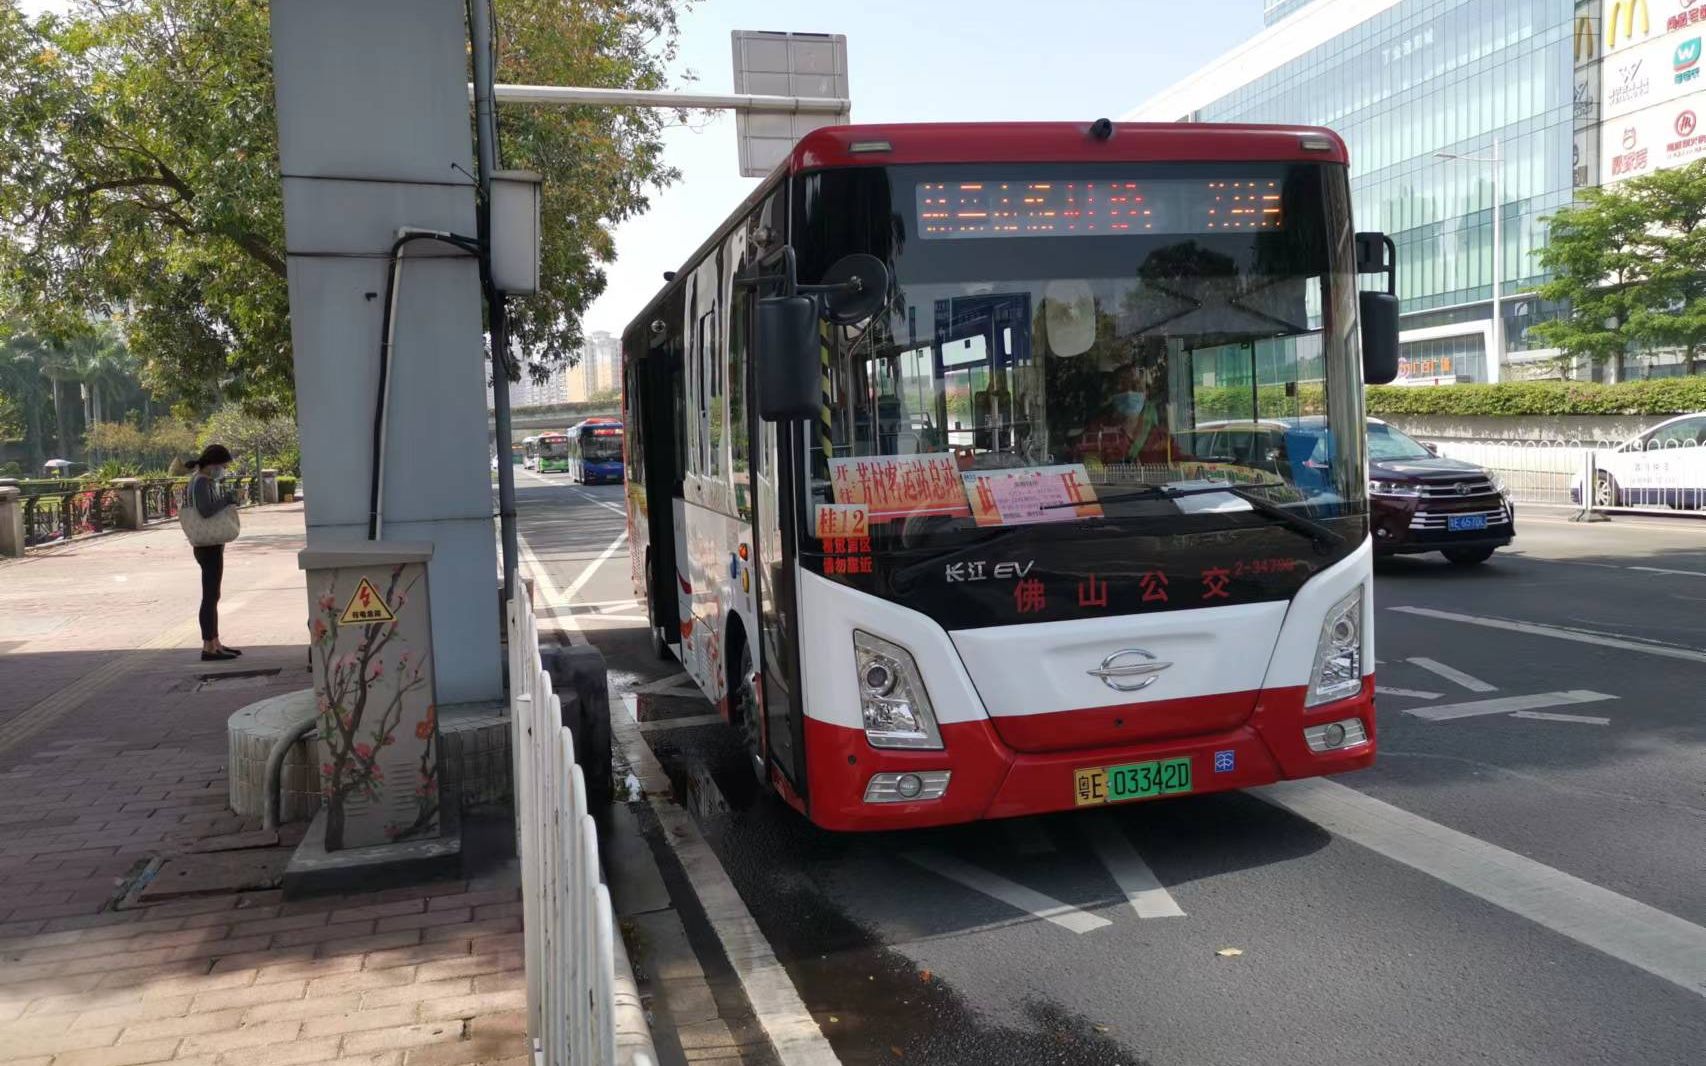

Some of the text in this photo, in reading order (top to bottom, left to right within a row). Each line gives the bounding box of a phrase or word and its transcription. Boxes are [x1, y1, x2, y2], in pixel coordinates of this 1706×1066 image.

[824, 557, 873, 574] 请勿靠近
[945, 560, 1034, 582] 长江 EV
[1013, 566, 1231, 613] 佛山公交
[1079, 762, 1189, 800] 粤E 03342D
